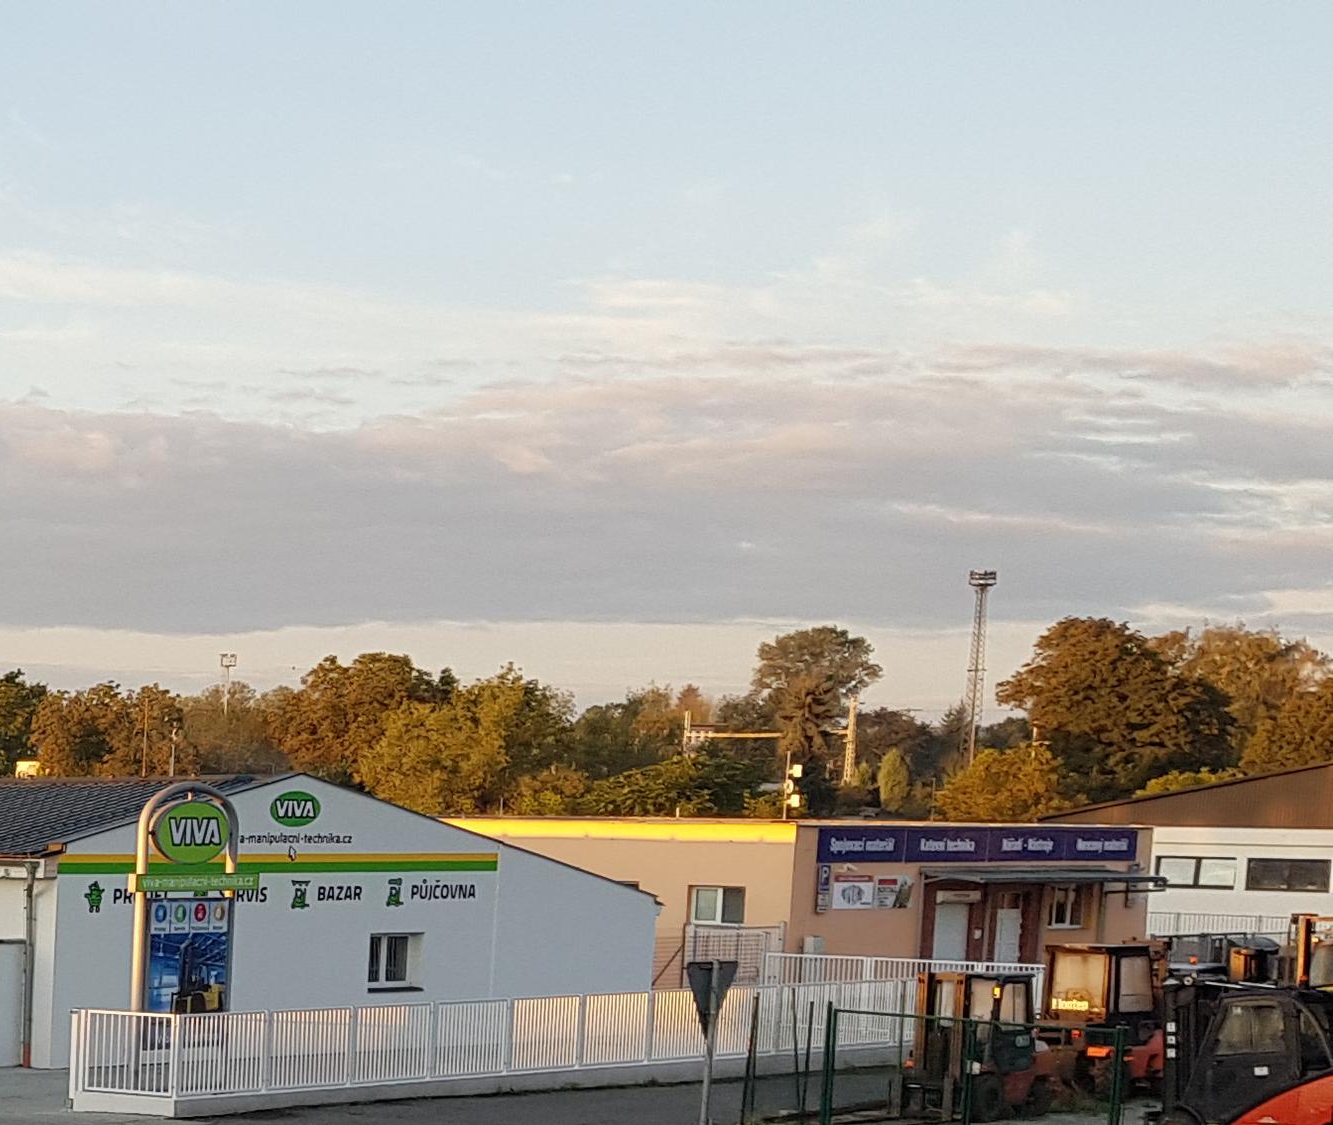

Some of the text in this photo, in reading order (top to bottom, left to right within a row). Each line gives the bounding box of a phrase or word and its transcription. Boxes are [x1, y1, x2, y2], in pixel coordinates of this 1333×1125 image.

[274, 799, 317, 819] VIVA
[169, 816, 222, 847] VIVA
[317, 886, 362, 901] BAZAR
[411, 879, 476, 900] PŮJČOVNA
